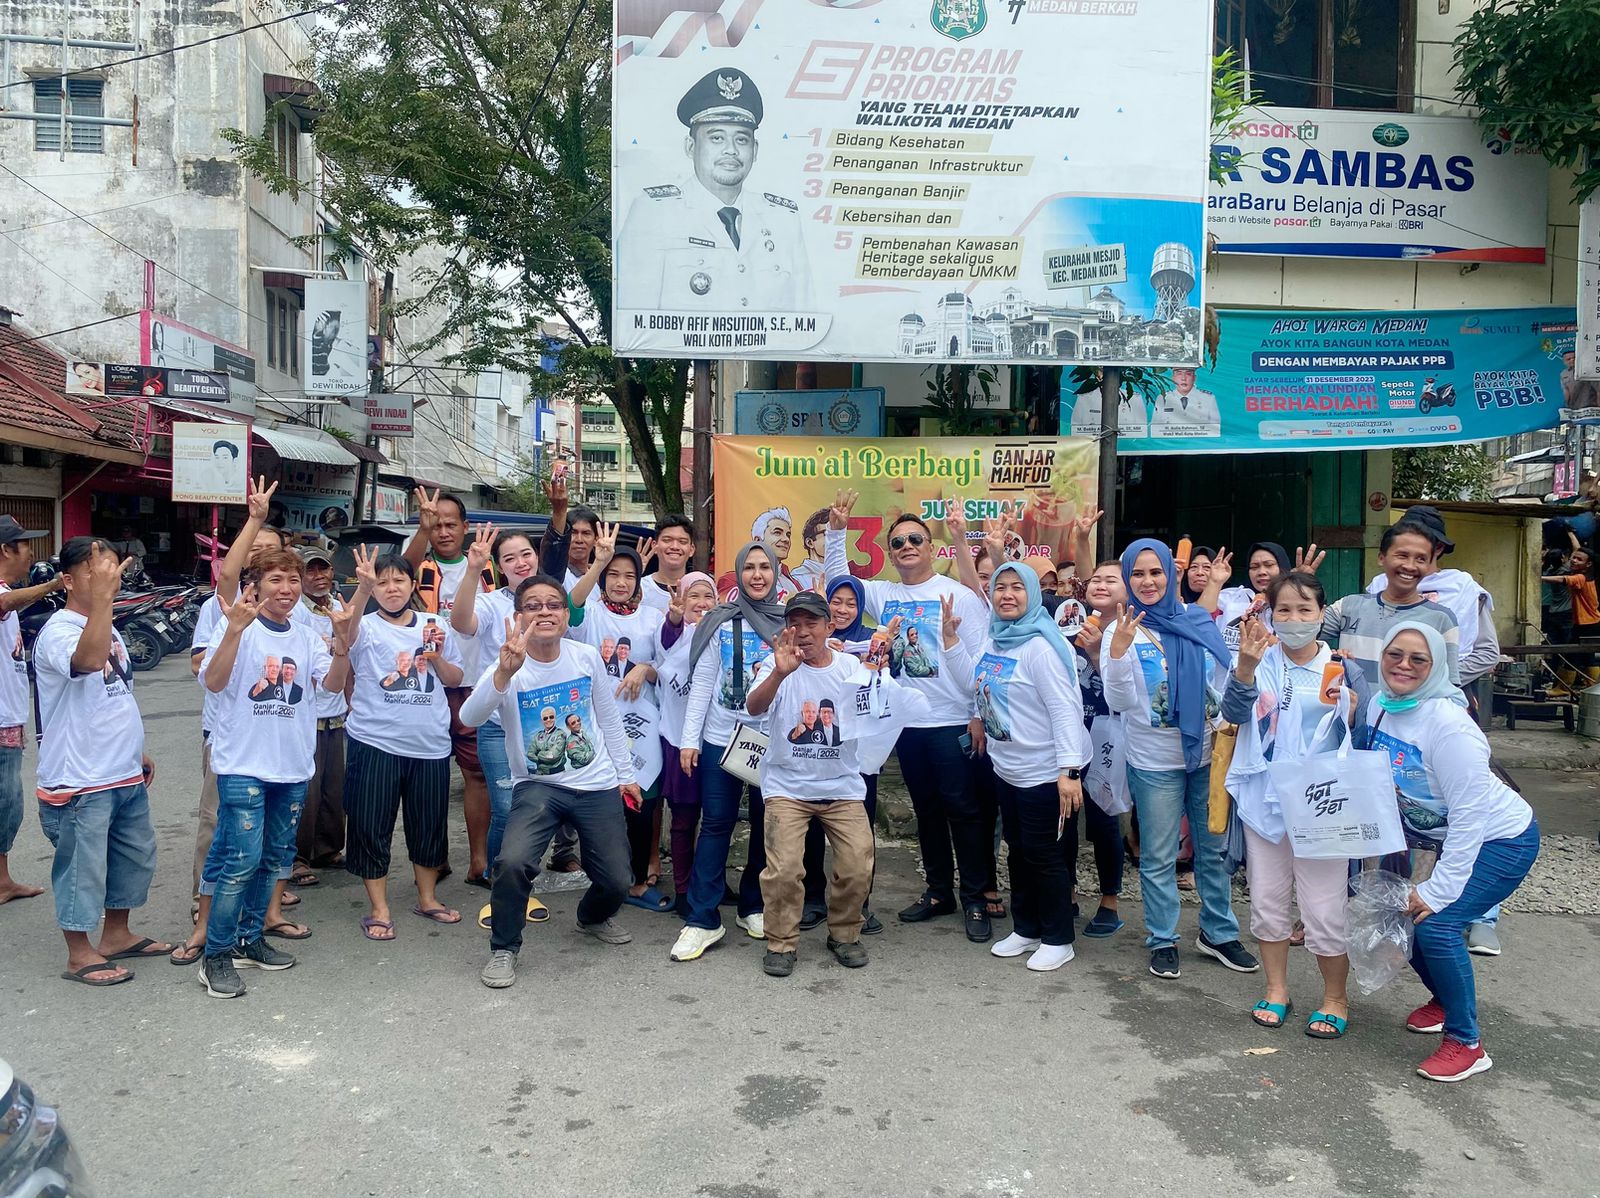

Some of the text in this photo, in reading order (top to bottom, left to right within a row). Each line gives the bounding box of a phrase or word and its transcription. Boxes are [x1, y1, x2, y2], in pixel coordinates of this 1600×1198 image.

[1029, 1, 1136, 15] MEDAN BERKAH
[870, 46, 1023, 74] PROGRAM
[862, 73, 1017, 103] PRIORITAS
[860, 101, 1079, 119] YANG TELAH DITETAPKAN
[856, 114, 1014, 130] WALIKOTA MEDAN
[807, 128, 823, 147] 1
[836, 133, 965, 149] Bidang Kesehatan
[803, 153, 824, 172] 2
[833, 156, 1023, 172] Penanganan Infrastruktur
[1260, 146, 1474, 192] SAMBAS
[803, 179, 824, 198] 3
[832, 183, 965, 199] Penanganan Banjir
[812, 205, 833, 224] 4
[1293, 195, 1362, 218] Belanja
[1369, 198, 1385, 216] di
[1392, 199, 1446, 218] Pasar
[842, 210, 952, 224] Kebersihan dan
[1229, 215, 1236, 223] di
[1237, 215, 1271, 225] Website
[1330, 218, 1368, 229] Bayarnya
[1370, 220, 1393, 229] Pakai
[1408, 221, 1424, 230] BRI
[834, 231, 853, 250] 5
[863, 237, 1019, 251] Pembenahan Kawasan
[862, 251, 994, 266] Heritage sekaligus
[1048, 248, 1120, 269] KELURAHAN MESJID
[862, 264, 1017, 280] Pemberdayaan UMKM
[1052, 264, 1118, 283] KEC. MEDAN KOTA
[634, 315, 816, 332] M. BOBBY AFIF NASUTION, S.E., M.M
[1271, 318, 1429, 335] AHOI WARGA MEDAN!
[683, 333, 766, 347] WALI KOTA MEDAN
[1261, 338, 1449, 348] AYOK KITA BANGUN KOTA MEDAN
[1259, 355, 1446, 367] DENGAN MEMBAYAR PAJAK PPB
[191, 374, 209, 383] TOKO
[1475, 369, 1538, 381] AYOK KITA
[174, 384, 225, 395] BEAUTY CENTRE
[1245, 384, 1376, 394] MENANGKAN UNDIAN
[1381, 381, 1414, 389] Sepeda
[1475, 378, 1538, 389] BAYAR PAJAK
[1389, 389, 1415, 397] Motor
[1476, 385, 1545, 410] PBB!
[1245, 395, 1379, 412] BERHADIAH!
[385, 408, 407, 418] INDAH
[992, 448, 1055, 466] GANJAR
[756, 446, 982, 488] Jum'at Berbagi
[990, 466, 1052, 484] MAHFUD
[320, 488, 352, 496] CENTRE
[848, 516, 885, 580] 3
[914, 606, 924, 617] 3
[1142, 650, 1157, 659] SAT
[609, 665, 616, 675] 3
[407, 679, 416, 688] 3
[275, 687, 282, 699] 3
[522, 697, 540, 709] SAT
[543, 693, 560, 705] SET
[569, 688, 580, 702] 3
[820, 750, 840, 758] 2024
